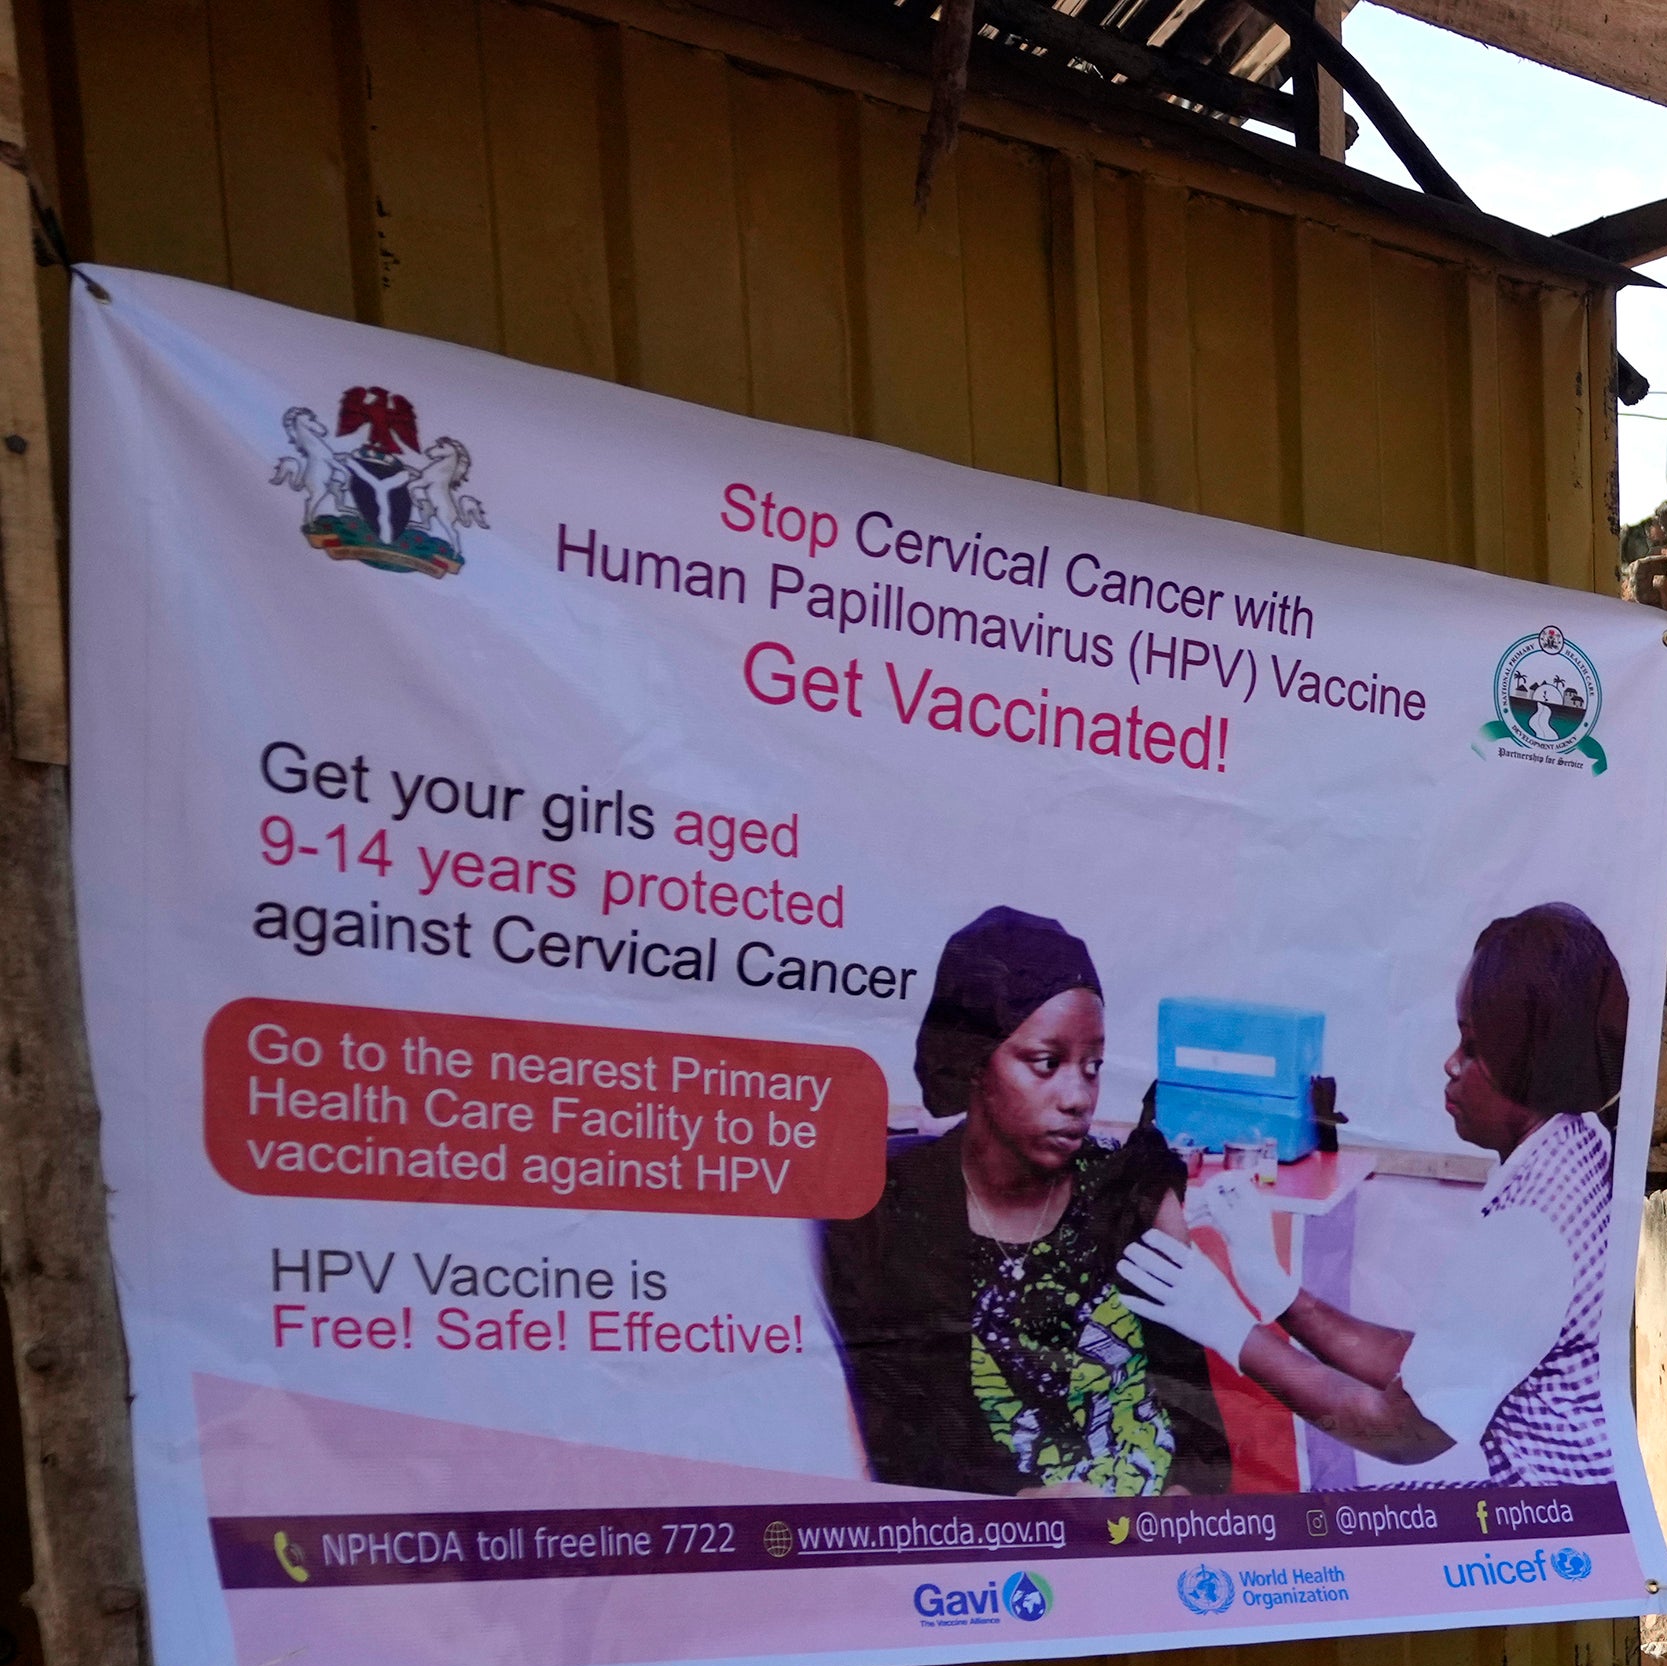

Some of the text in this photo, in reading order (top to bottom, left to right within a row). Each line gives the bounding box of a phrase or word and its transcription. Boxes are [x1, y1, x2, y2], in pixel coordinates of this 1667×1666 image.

[721, 483, 1313, 639] Stop Cervical Cancer with
[558, 523, 1425, 720] Human Papillomavirus (HPV) Vaccine
[1500, 643, 1595, 706] NATIONAL PRIMARY HEALTH CARE
[744, 642, 1230, 773] Get Vaccinated!
[1498, 747, 1584, 769] Partnership for Service
[1512, 725, 1577, 750] DEVELOPMENT AGENCY
[261, 741, 797, 862] Get your girls aged
[261, 816, 843, 928] 9-14 years protected
[253, 901, 917, 999] against Cervical Cancer
[248, 1024, 831, 1111] Go to the nearest Primary
[250, 1076, 816, 1151] Health Care Facility to be
[247, 1137, 790, 1194] vaccinated against HPV
[272, 1248, 667, 1300] HPV Vaccine is
[274, 1304, 802, 1353] Free! Safe! Effective!
[798, 1517, 1066, 1554] www.nphcda.gov.ng
[1136, 1509, 1276, 1544] @nphcdang
[1336, 1504, 1437, 1536] @nphcda
[1496, 1499, 1573, 1530] nphcda
[323, 1531, 463, 1565] NPHCDA
[477, 1528, 523, 1561] toll
[662, 1523, 735, 1553] 7722
[1239, 1566, 1344, 1586] World Health
[1444, 1549, 1546, 1588] unicef
[914, 1581, 998, 1617] Gavi
[1243, 1586, 1349, 1609] Organization
[920, 1617, 1000, 1628] The Vaccine Alliance
